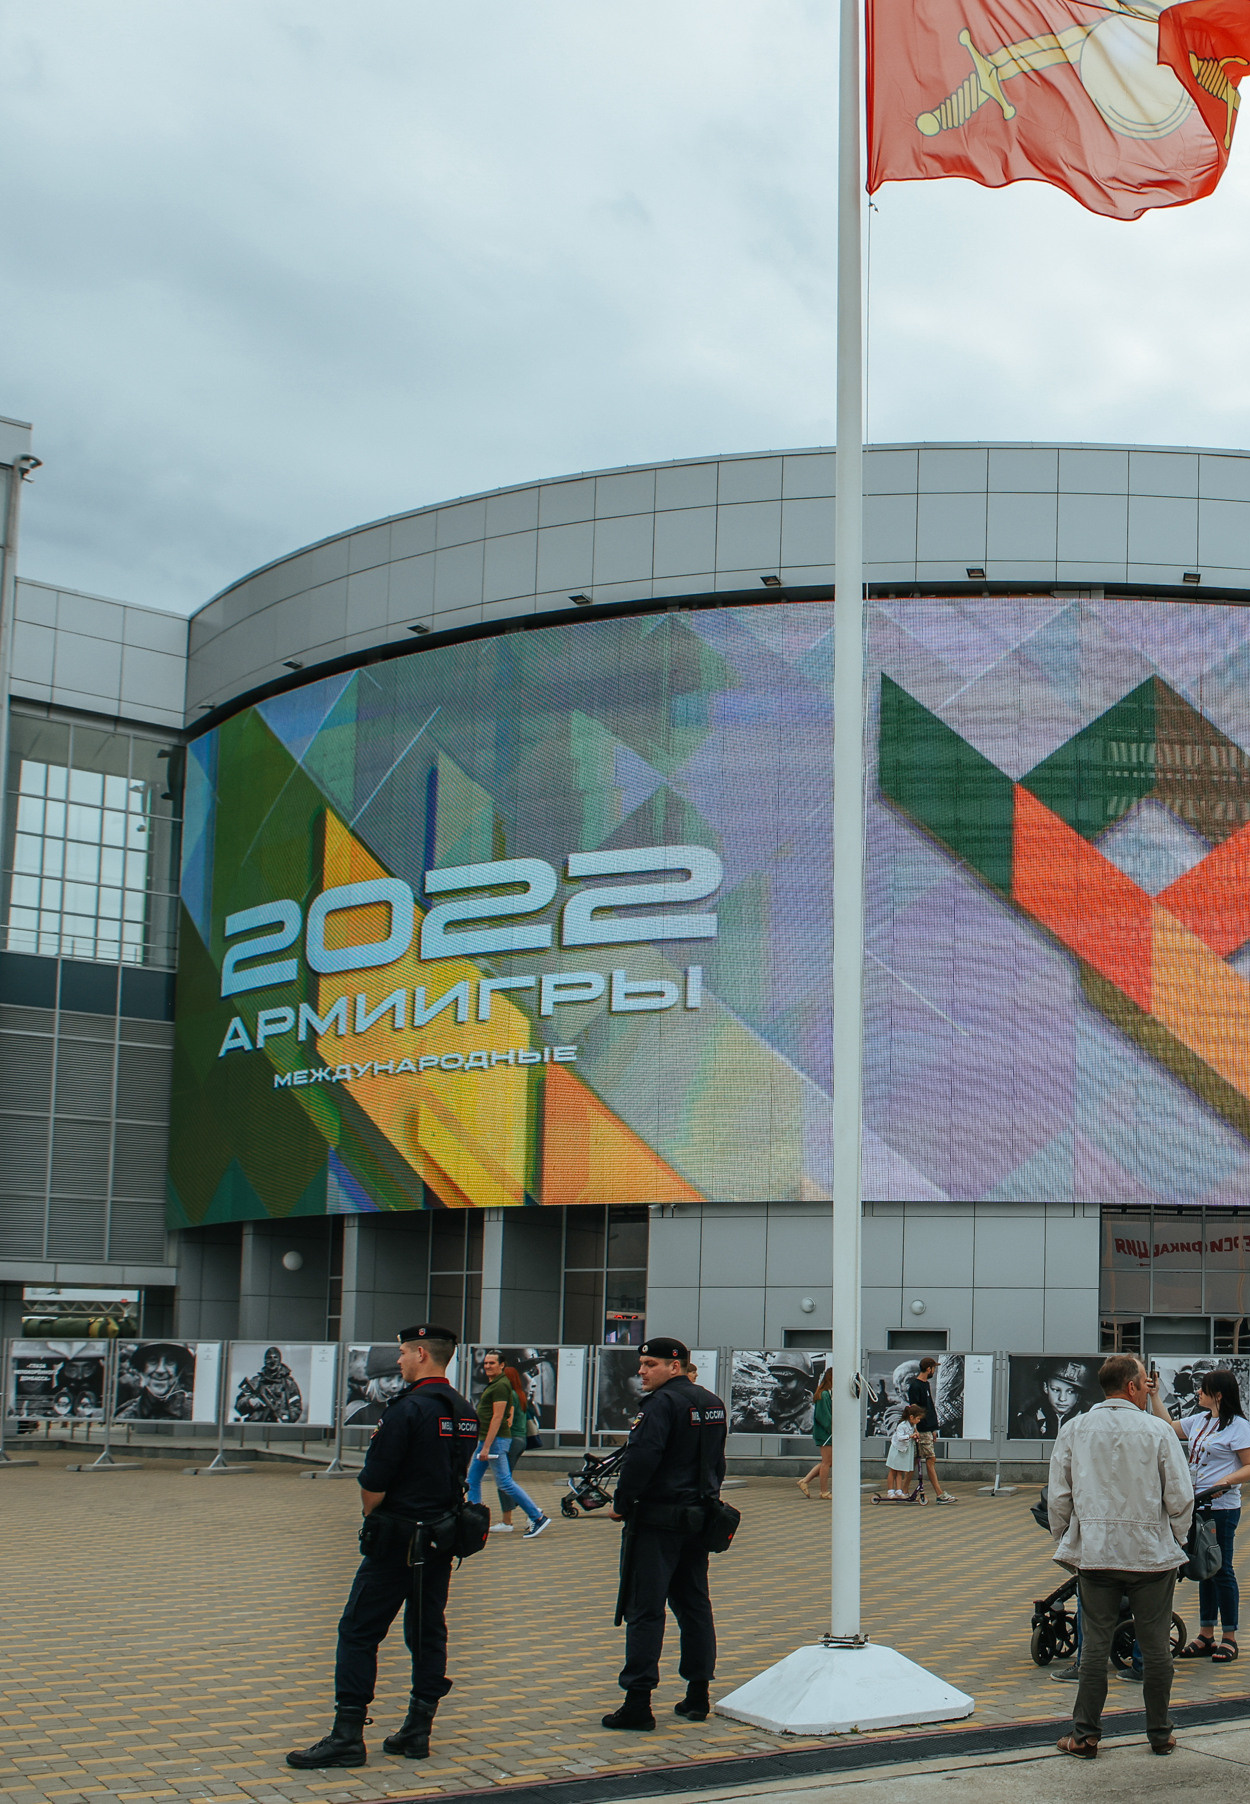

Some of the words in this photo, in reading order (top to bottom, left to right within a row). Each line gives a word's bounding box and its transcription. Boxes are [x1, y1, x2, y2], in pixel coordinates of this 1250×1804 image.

[219, 844, 725, 998] 2022
[218, 965, 702, 1057] АРМИИГРЫ
[274, 1045, 578, 1089] МЕЖДУНАРОДНЫЕ
